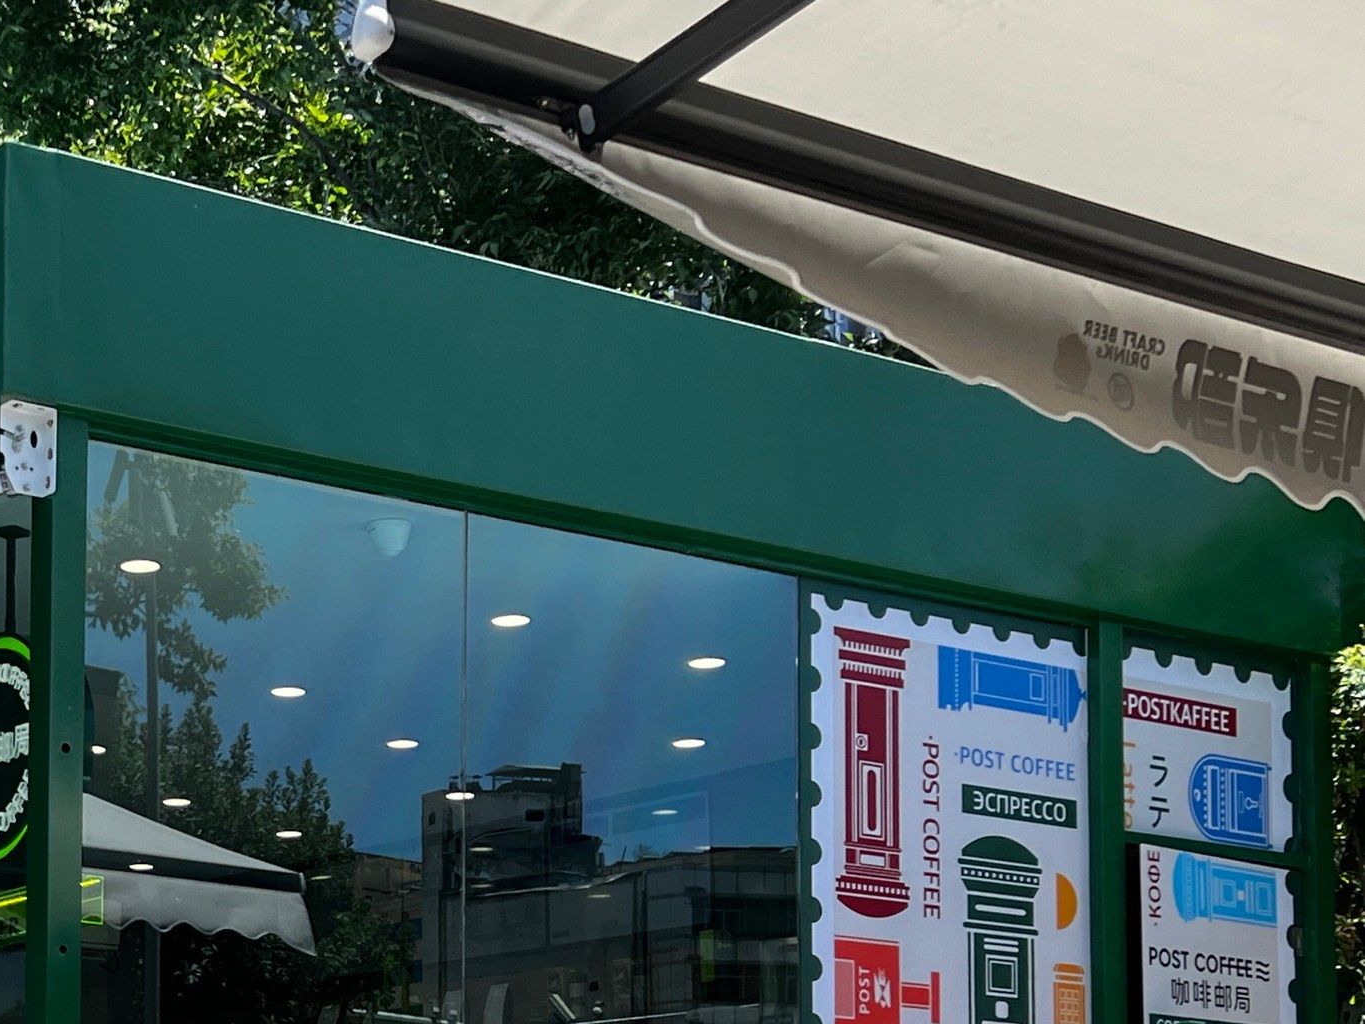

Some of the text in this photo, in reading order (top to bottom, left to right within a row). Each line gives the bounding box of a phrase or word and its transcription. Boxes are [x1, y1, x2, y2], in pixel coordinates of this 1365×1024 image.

[1011, 754, 1076, 782] COFFEE
[972, 790, 1067, 822] ЭСПРЕССО
[1149, 755, 1170, 828] ラテ
[922, 818, 941, 919] COFFEE
[1148, 946, 1253, 979] POST COFFEE
[858, 965, 871, 1015] POST
[1171, 977, 1251, 1014] 咖啡邮局
